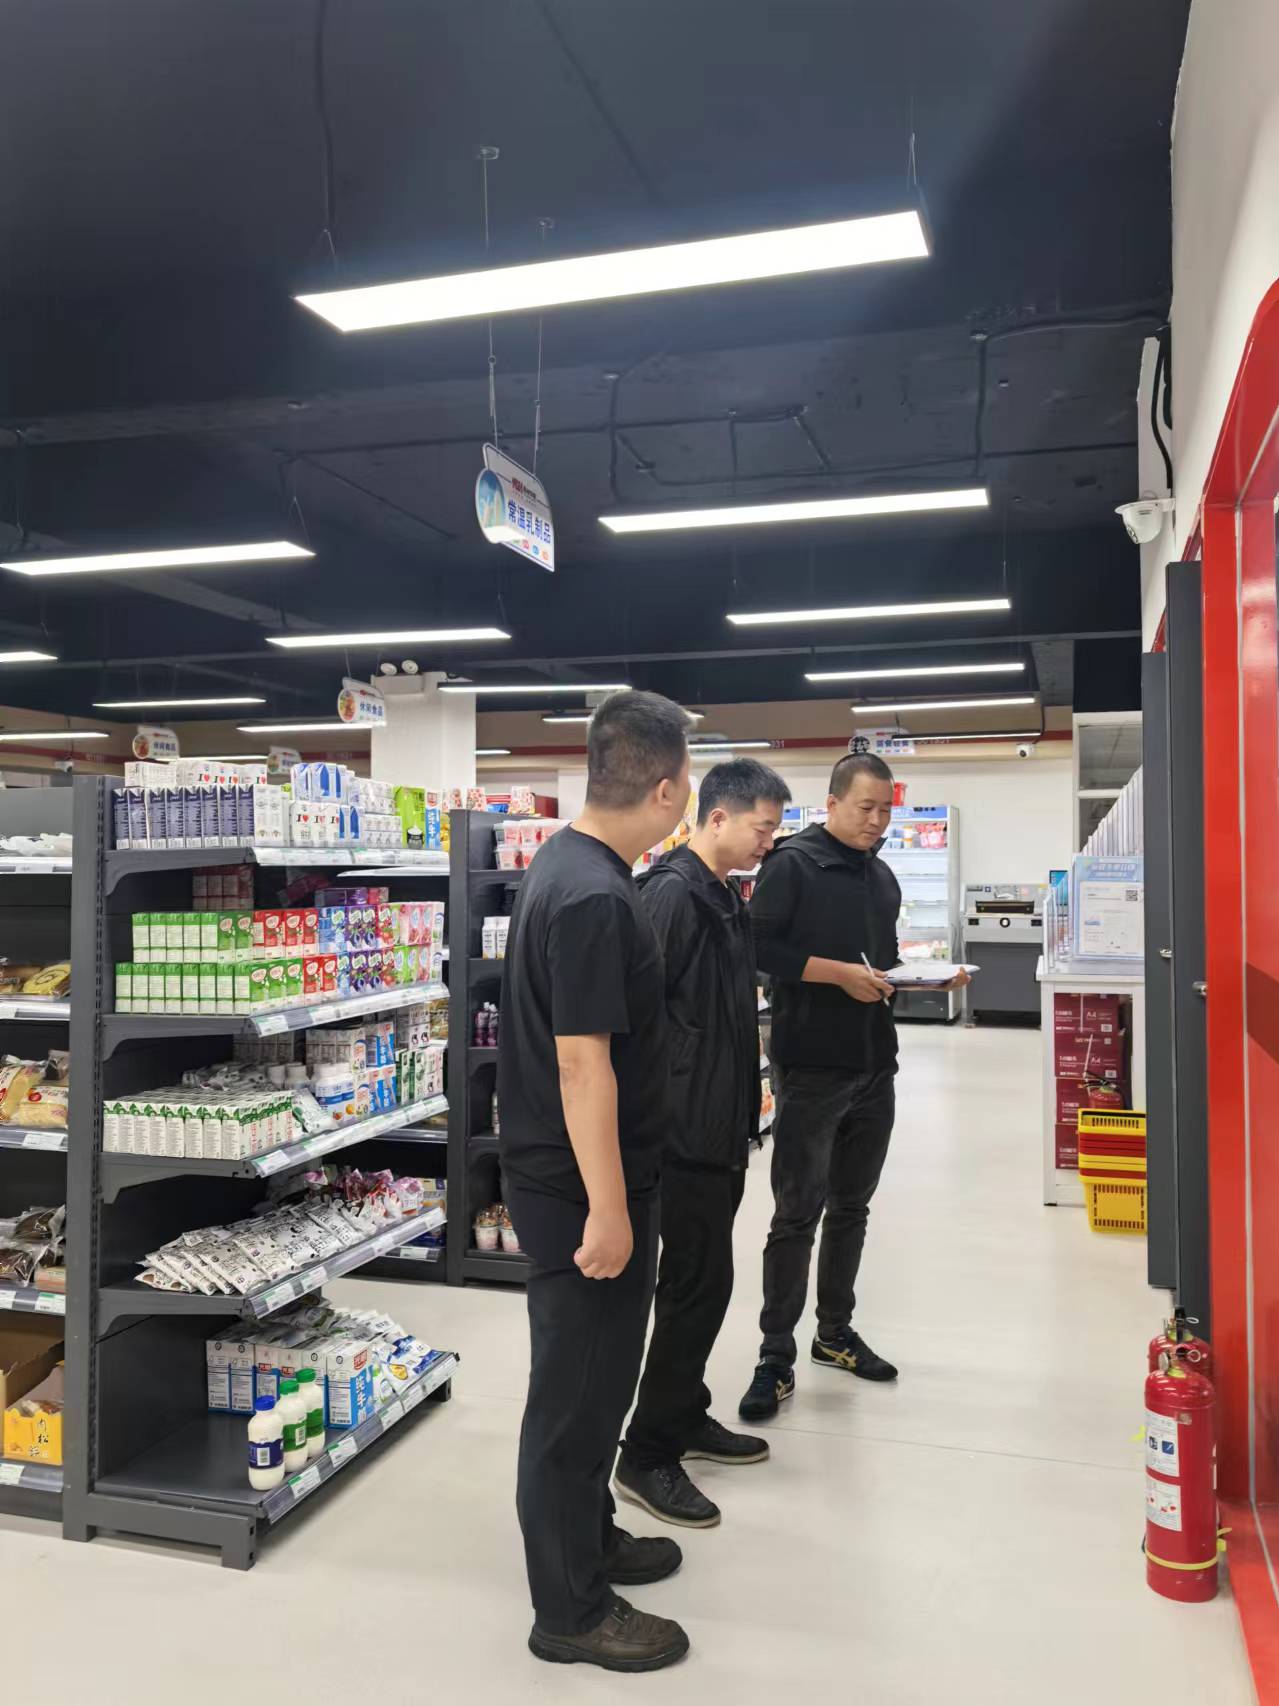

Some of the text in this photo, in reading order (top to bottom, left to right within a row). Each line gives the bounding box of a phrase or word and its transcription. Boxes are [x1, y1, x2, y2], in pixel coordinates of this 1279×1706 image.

[508, 499, 551, 544] 常温乳制品
[360, 701, 383, 717] 休闲食品
